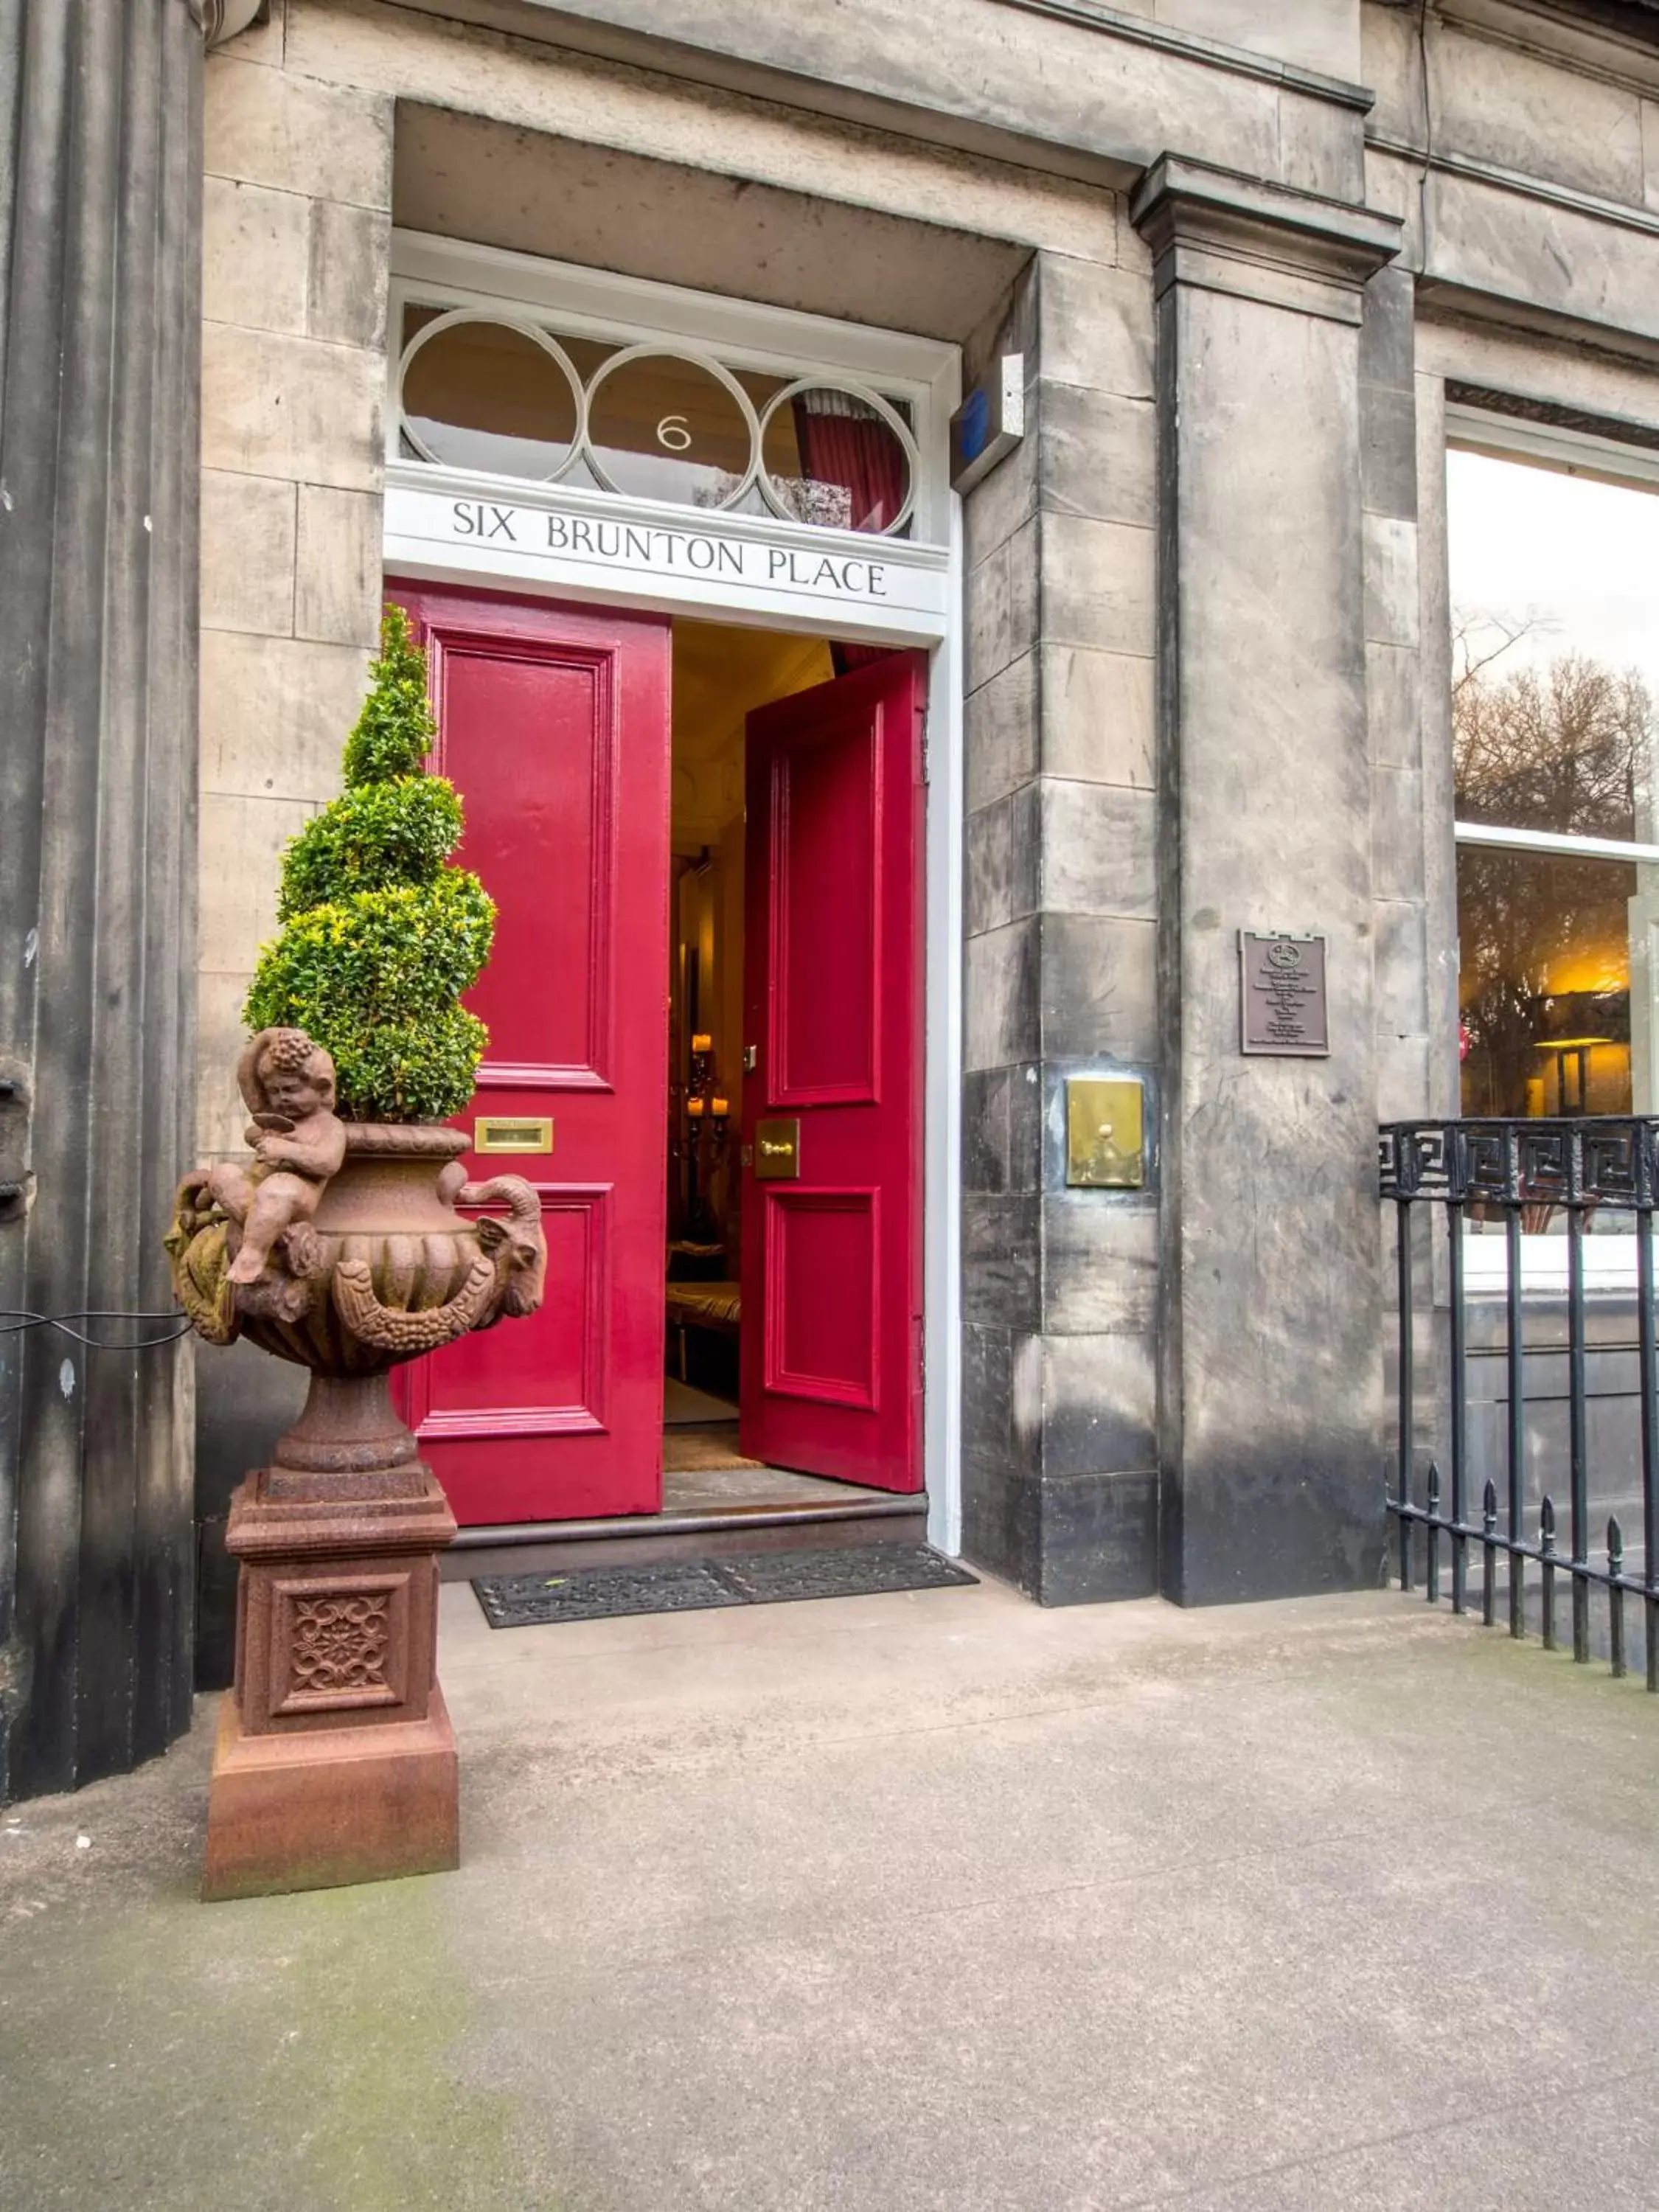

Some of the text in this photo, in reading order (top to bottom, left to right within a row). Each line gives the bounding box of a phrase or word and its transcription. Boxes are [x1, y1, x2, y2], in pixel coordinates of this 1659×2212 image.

[657, 415, 692, 450] 6
[453, 502, 886, 596] SIX BRUNTON PLACE
